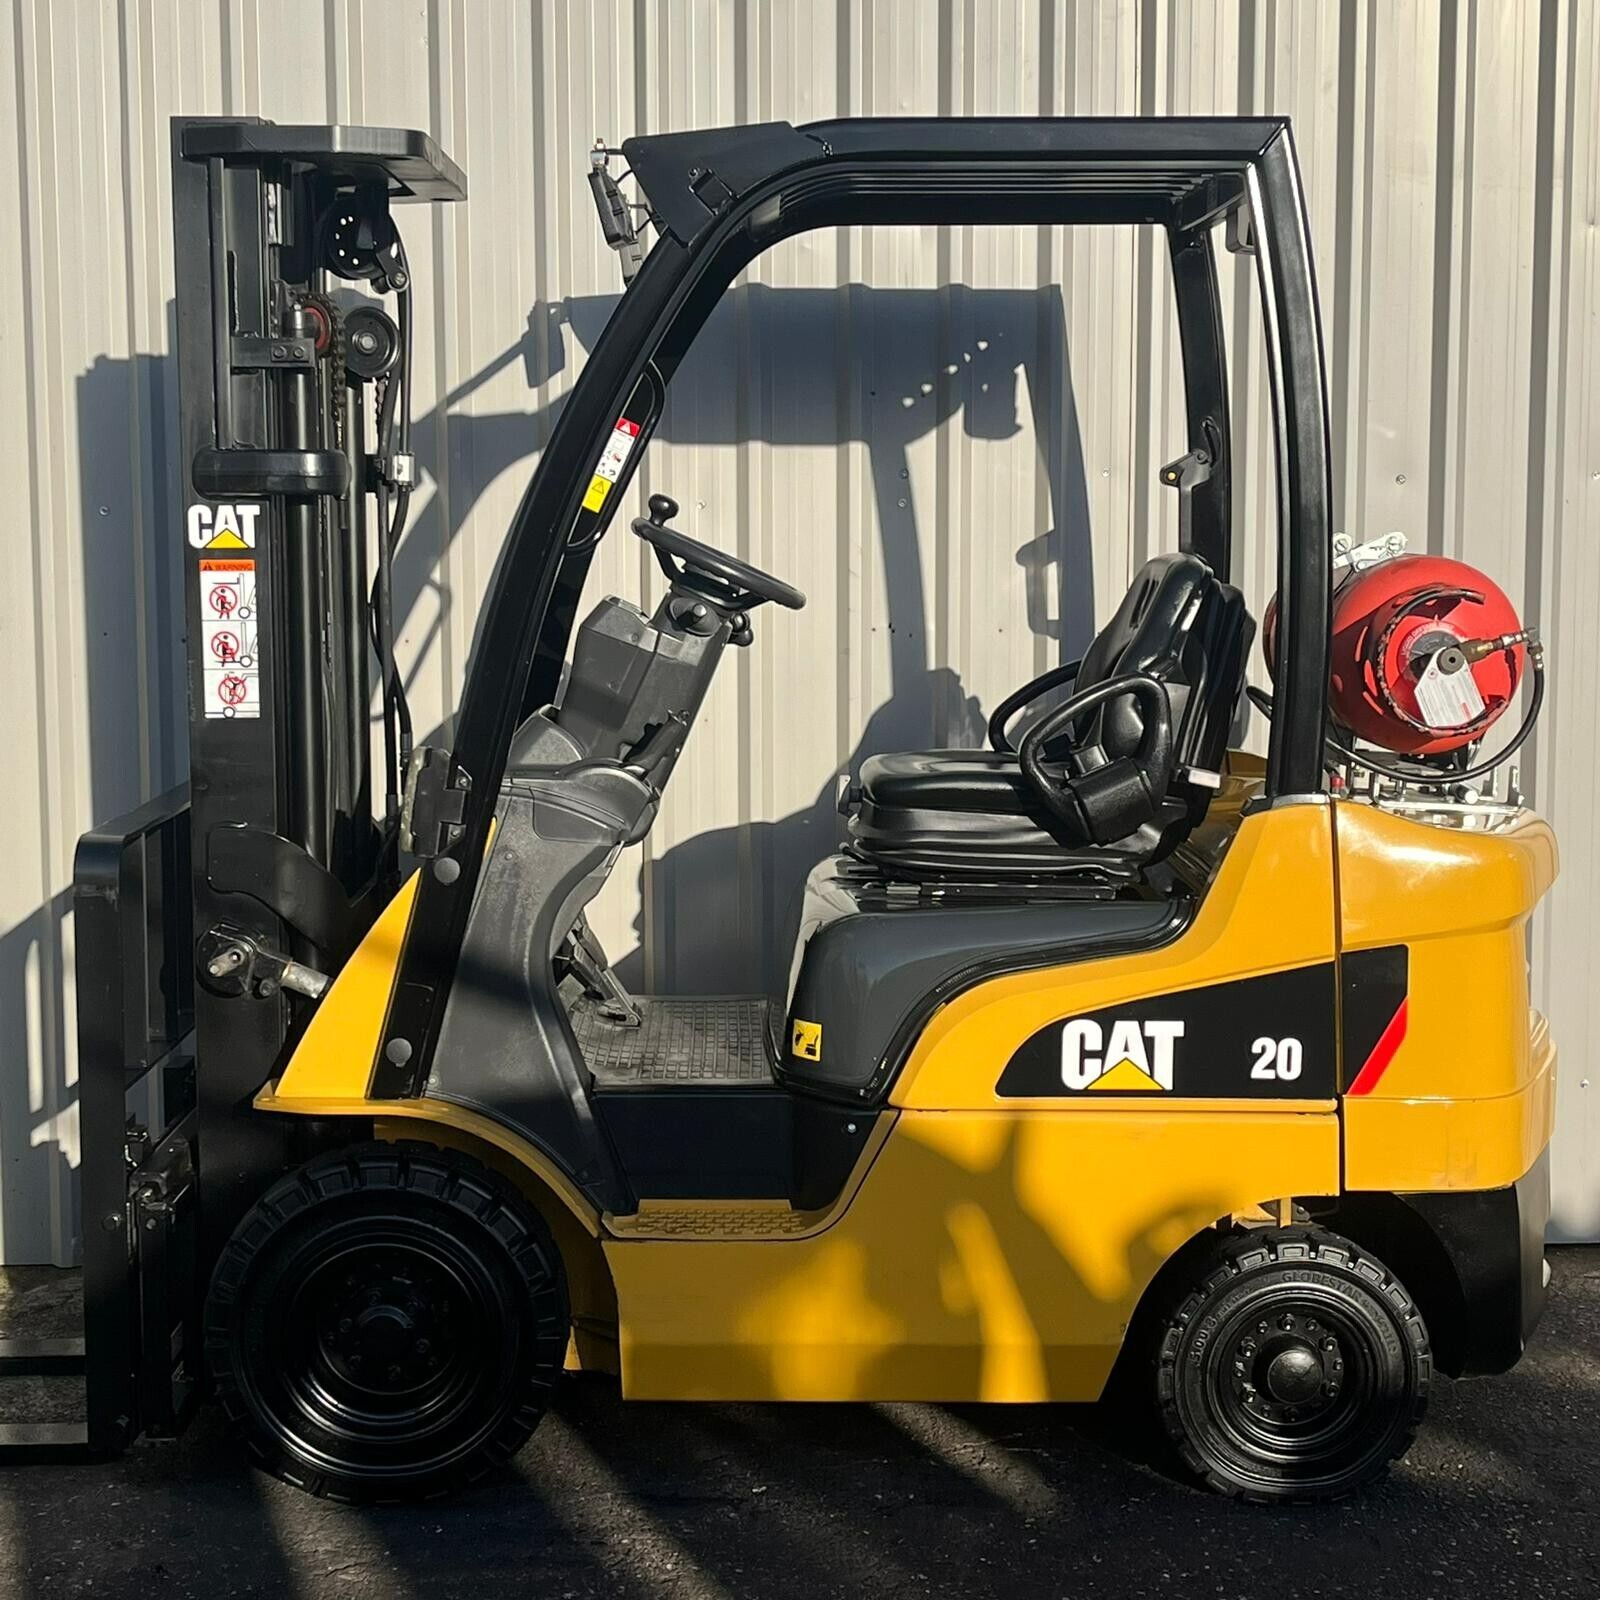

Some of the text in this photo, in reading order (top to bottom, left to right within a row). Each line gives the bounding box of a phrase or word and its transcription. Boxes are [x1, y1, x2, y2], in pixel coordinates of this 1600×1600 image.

[187, 504, 260, 549] CAT
[215, 563, 254, 571] WARNING
[1061, 1018, 1303, 1091] CAT 20
[1282, 1271, 1362, 1302] GLOBESTAR
